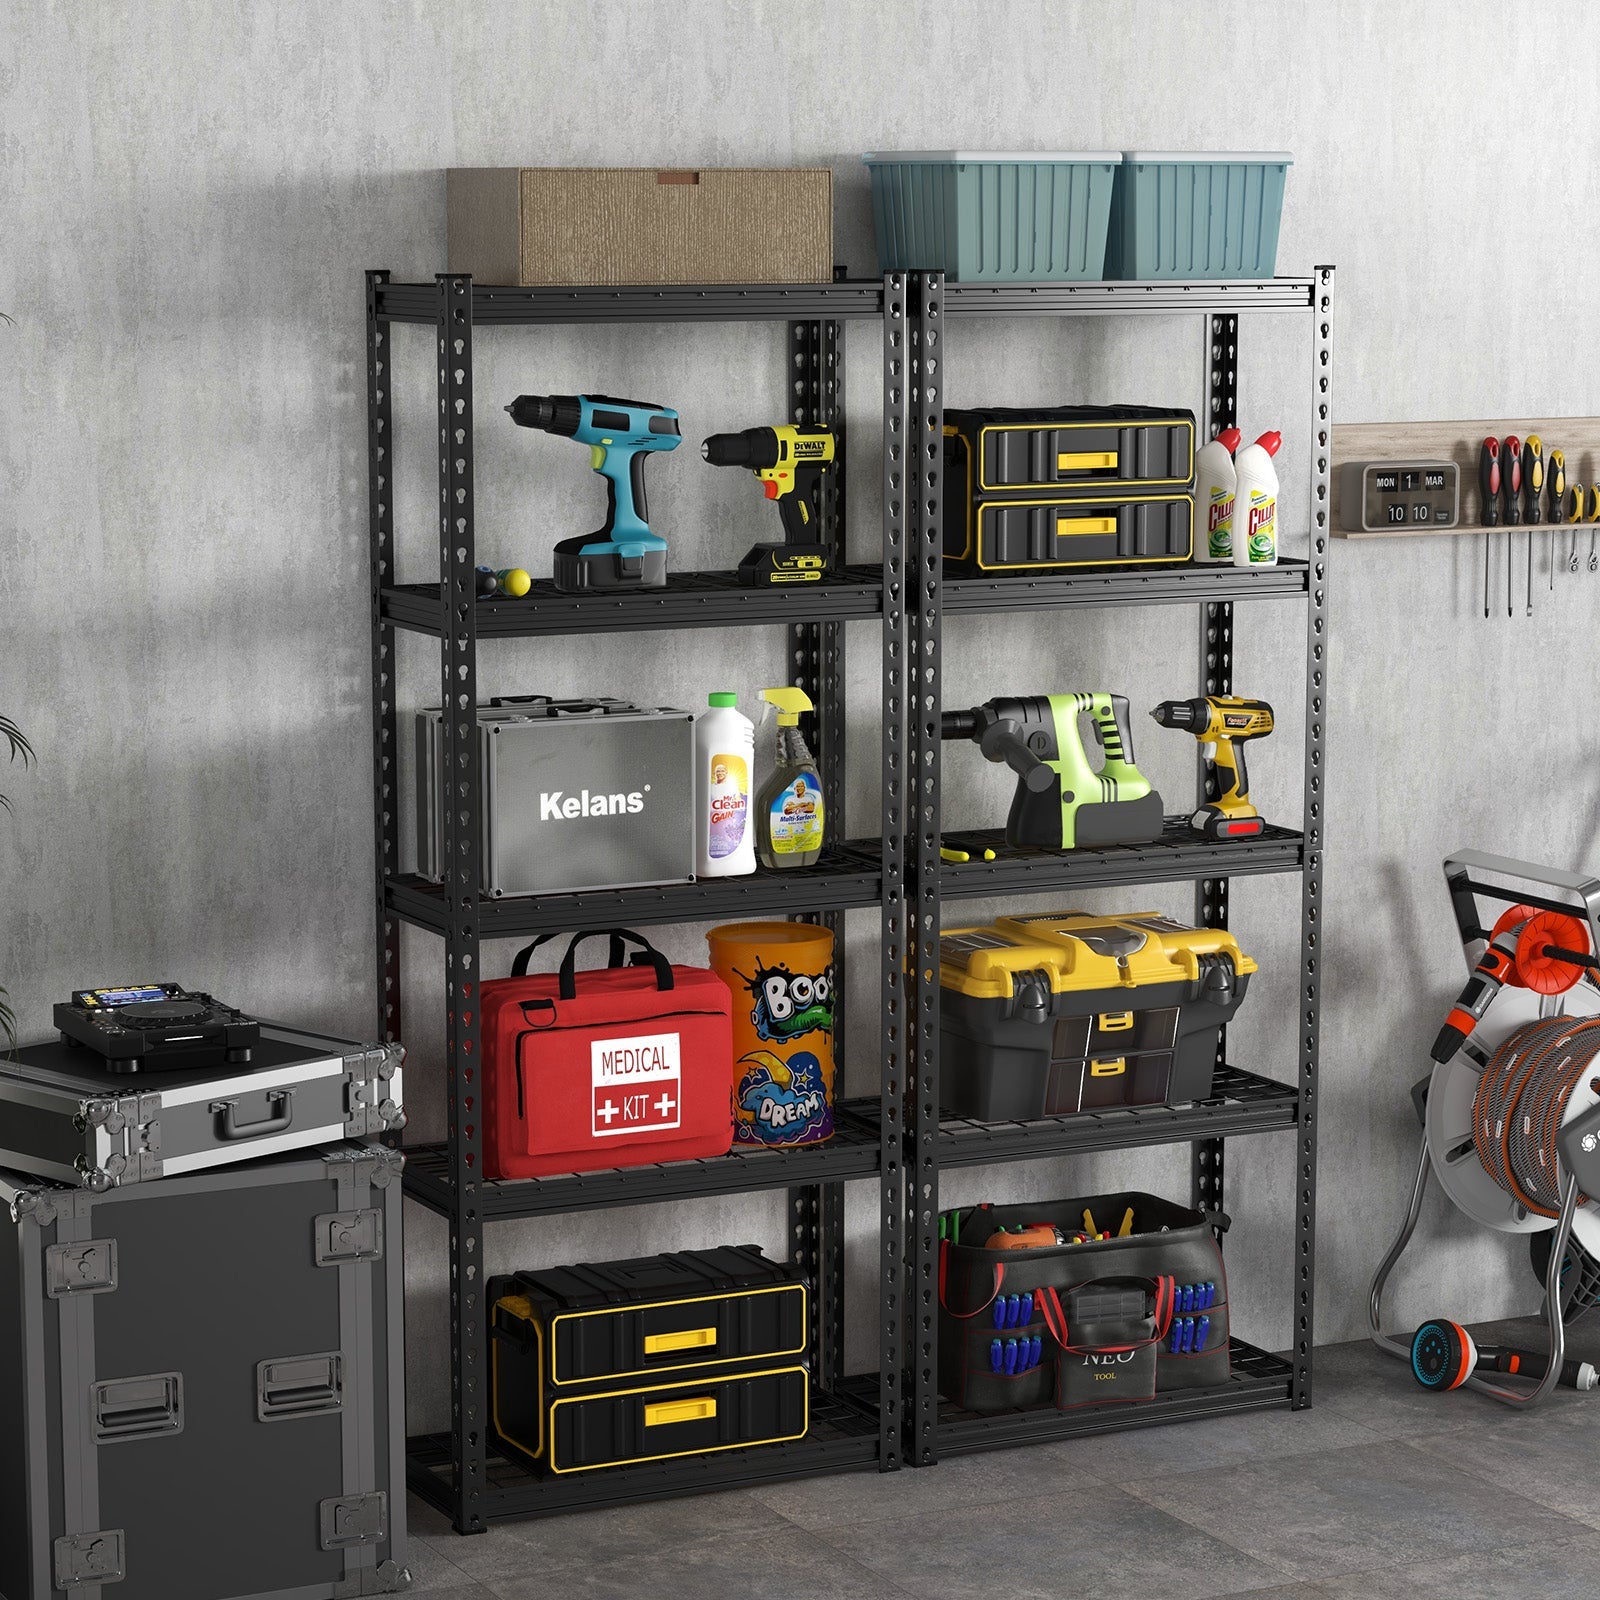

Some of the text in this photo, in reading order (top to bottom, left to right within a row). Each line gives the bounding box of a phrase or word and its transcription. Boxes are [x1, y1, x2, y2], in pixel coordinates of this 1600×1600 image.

[1376, 474, 1443, 489] MON 1 MAR
[1388, 506, 1404, 521] 10
[1412, 506, 1428, 520] 10
[711, 800, 744, 810] Clean
[711, 811, 734, 824] GAIN
[602, 1046, 670, 1076] MEDICAL
[623, 1094, 650, 1121] KIT
[759, 1092, 820, 1128] DREAM
[1094, 1372, 1117, 1381] TOOL
